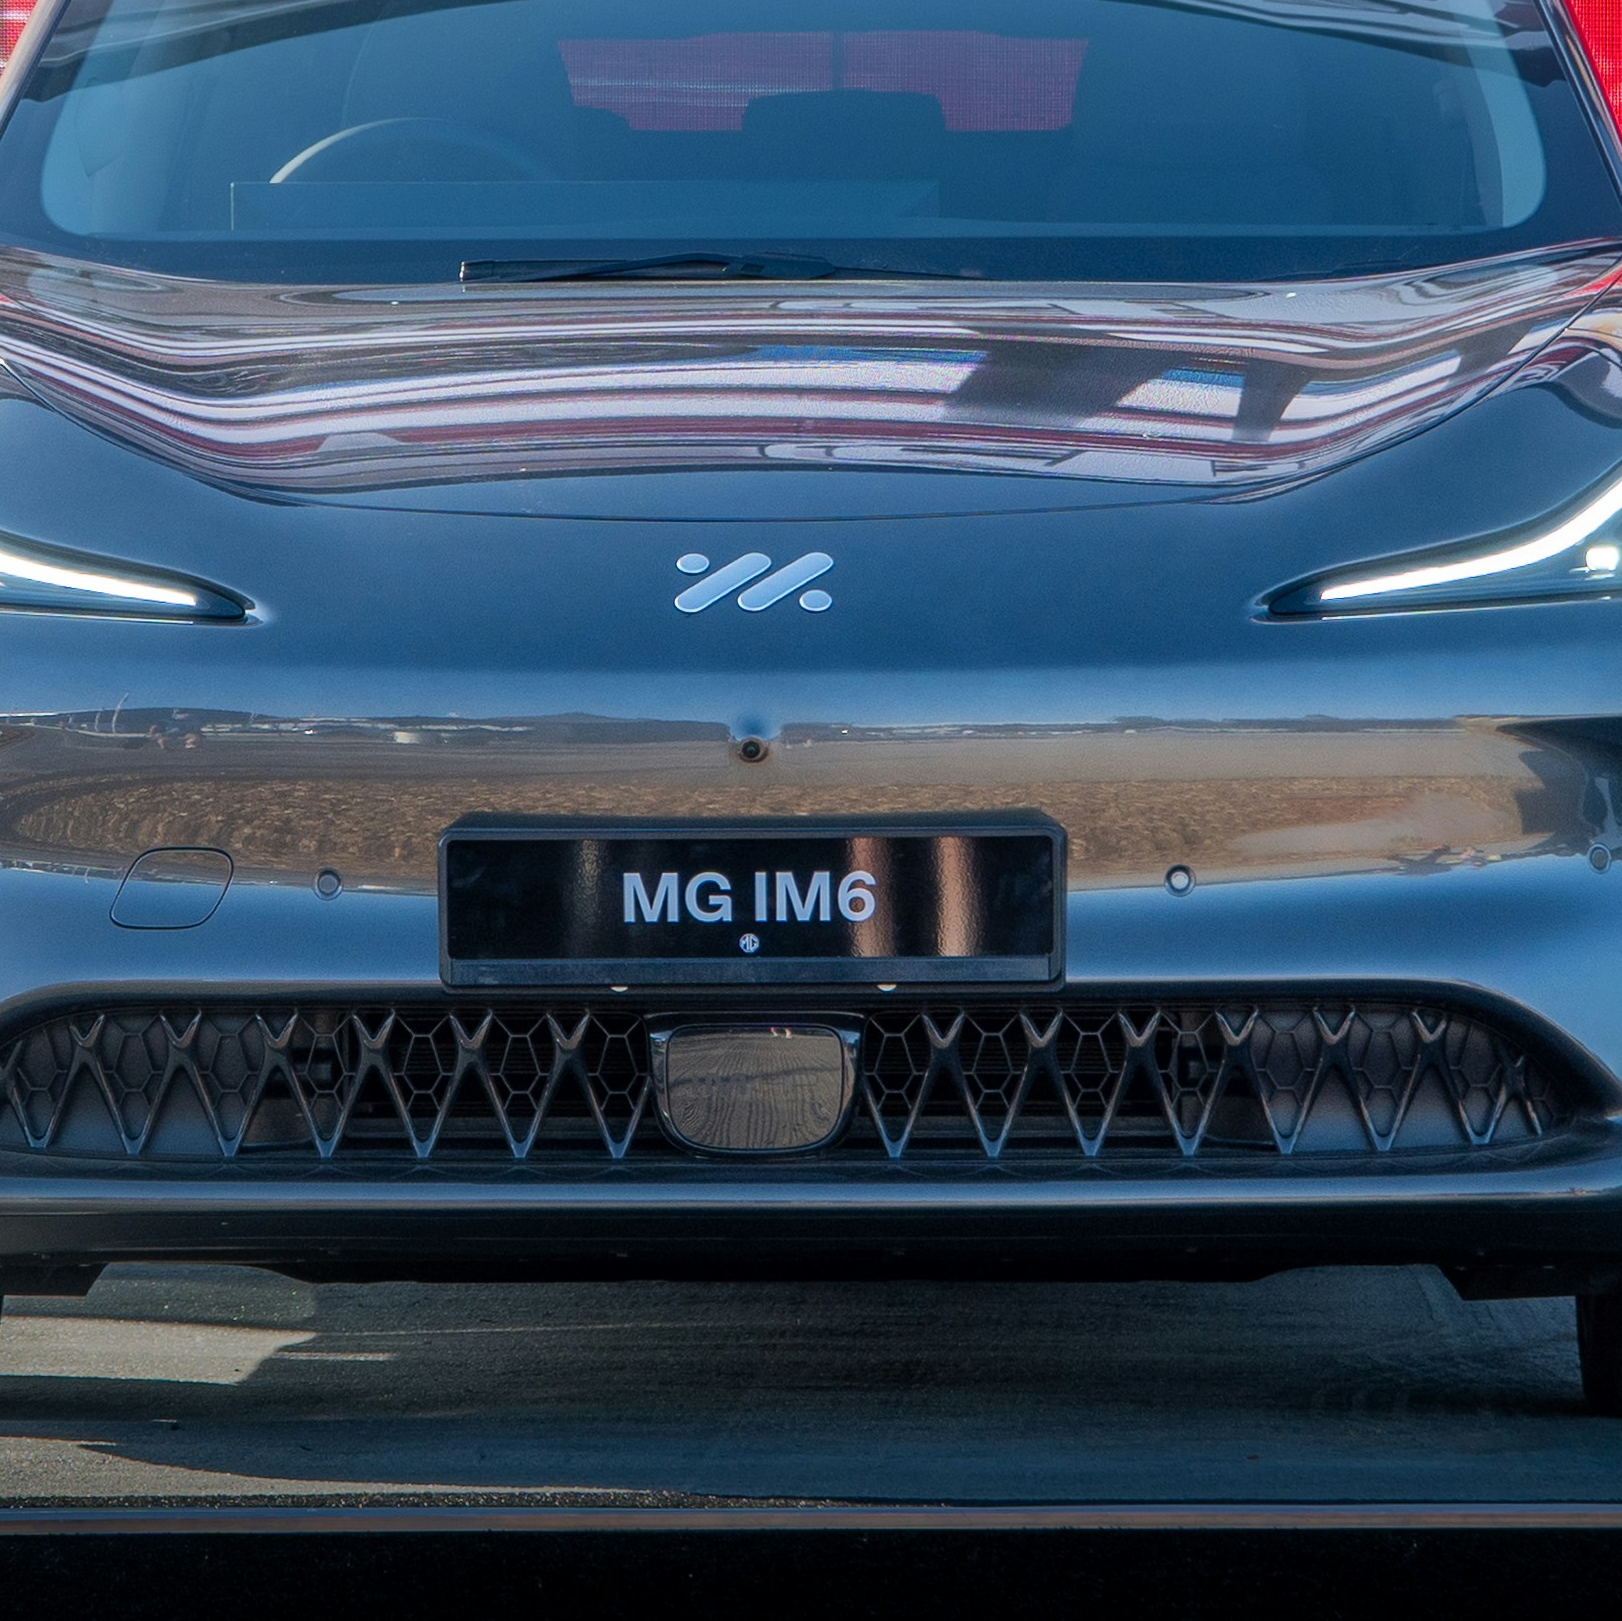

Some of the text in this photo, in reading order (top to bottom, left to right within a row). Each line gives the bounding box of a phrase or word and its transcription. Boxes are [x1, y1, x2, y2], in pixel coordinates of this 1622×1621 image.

[623, 870, 877, 923] MG IM6
[739, 933, 760, 954] MG
